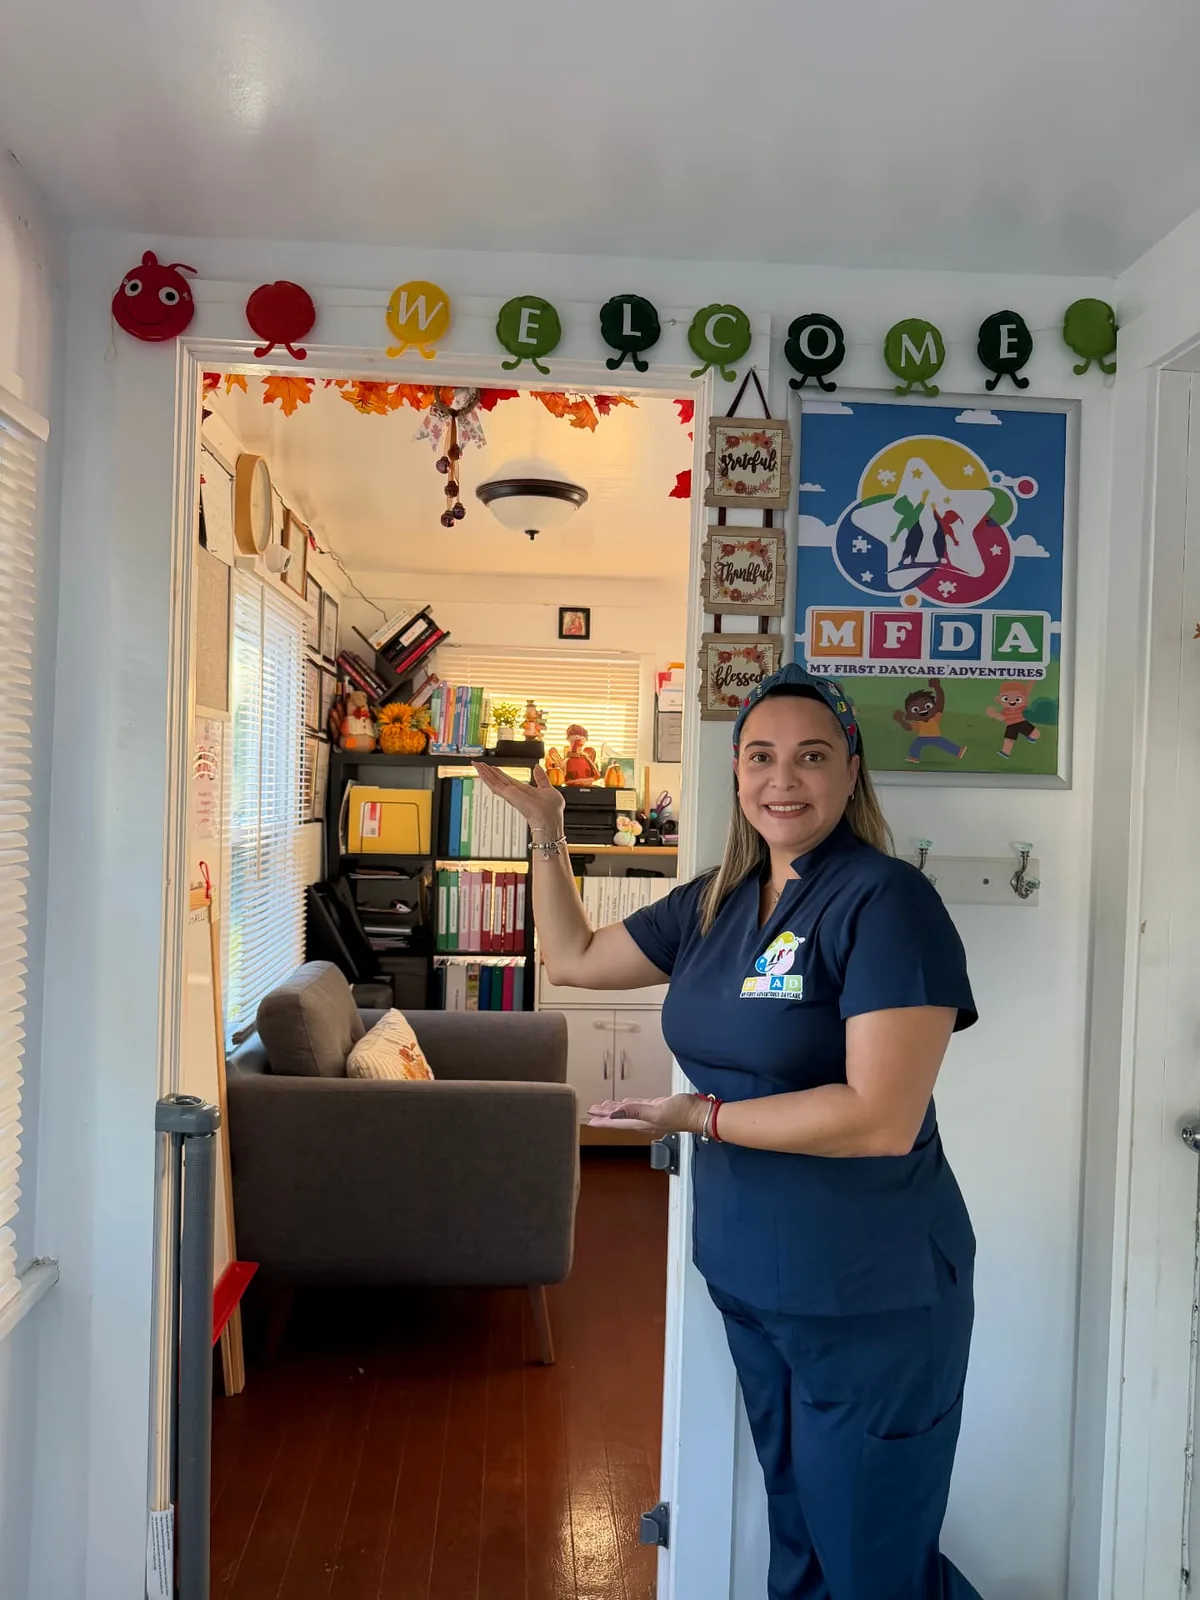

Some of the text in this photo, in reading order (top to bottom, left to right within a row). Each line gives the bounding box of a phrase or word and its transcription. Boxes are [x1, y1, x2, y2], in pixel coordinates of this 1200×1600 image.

[399, 291, 1018, 367] WELCOME
[721, 449, 777, 477] grateful
[715, 561, 773, 585] Thankful
[819, 620, 1038, 653] MFDA
[810, 664, 1043, 677] MY FIRST DAYCARE ADVENTURES
